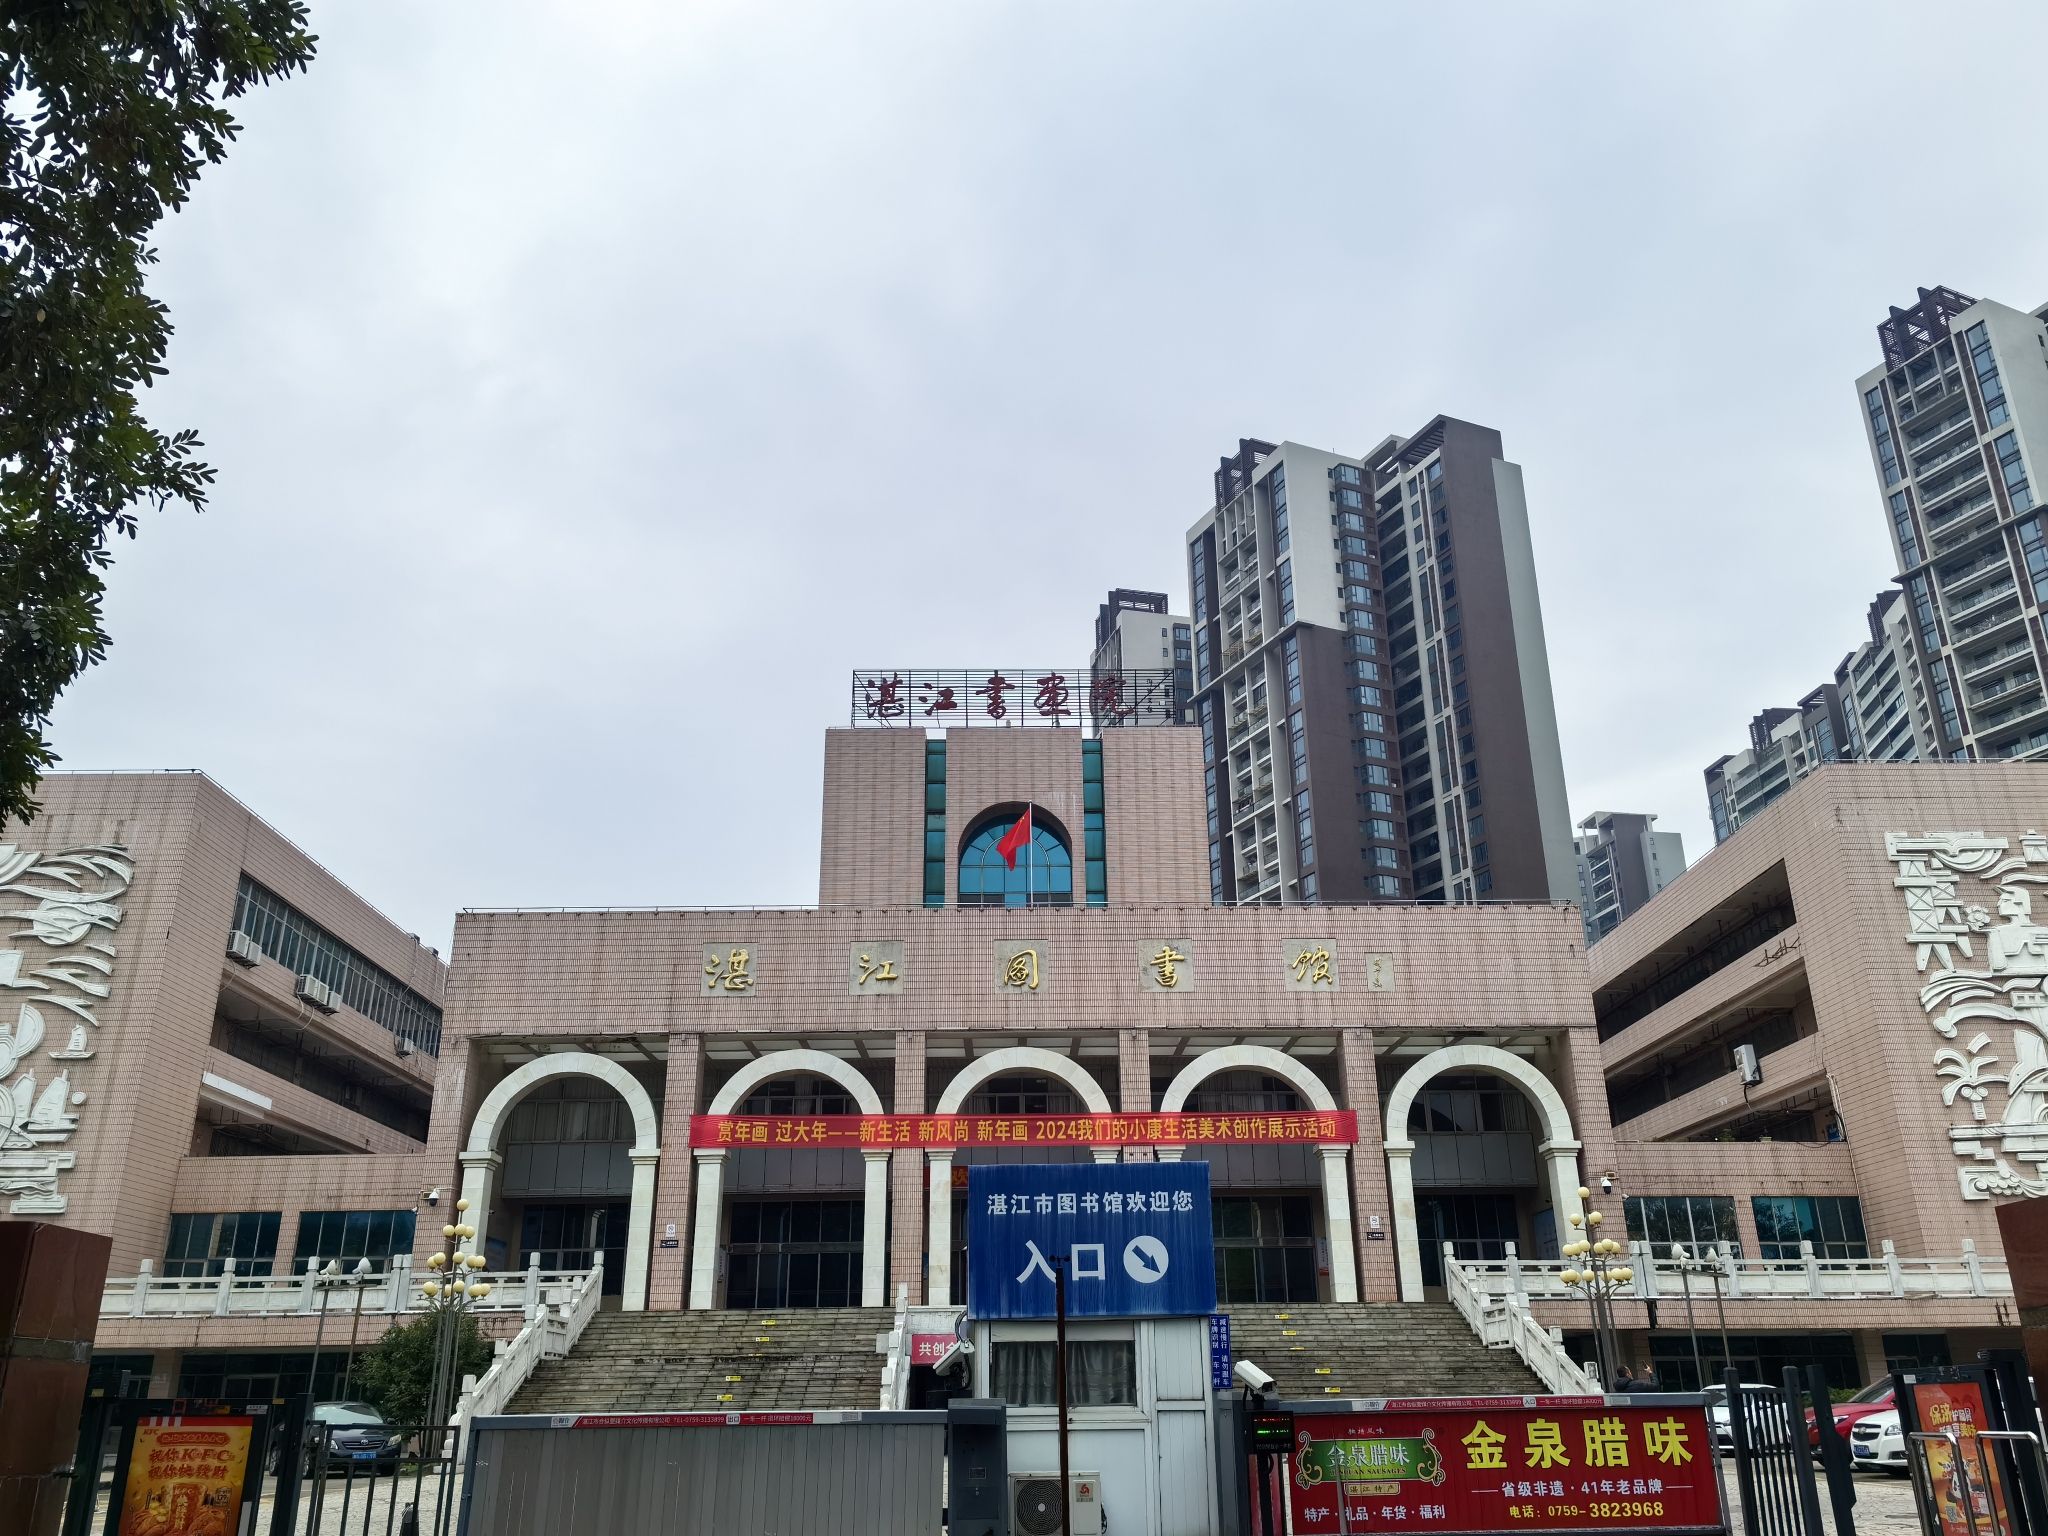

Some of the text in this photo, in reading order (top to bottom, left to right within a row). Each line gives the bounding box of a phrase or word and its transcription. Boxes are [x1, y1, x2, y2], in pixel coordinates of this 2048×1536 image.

[717, 1121, 769, 1143] 赏年画
[918, 1119, 970, 1142] 新风尚
[977, 1119, 1029, 1141] 新年画
[1035, 1116, 1337, 1141] 2024我们的小康生活美术创作展示活动
[987, 1190, 1194, 1215] 湛江市图书馆欢迎您
[1016, 1239, 1106, 1284] 入口
[728, 1415, 740, 1423] 出口
[1460, 1416, 1693, 1469] 金泉腊味
[1547, 1501, 1664, 1517] 0759-3823968
